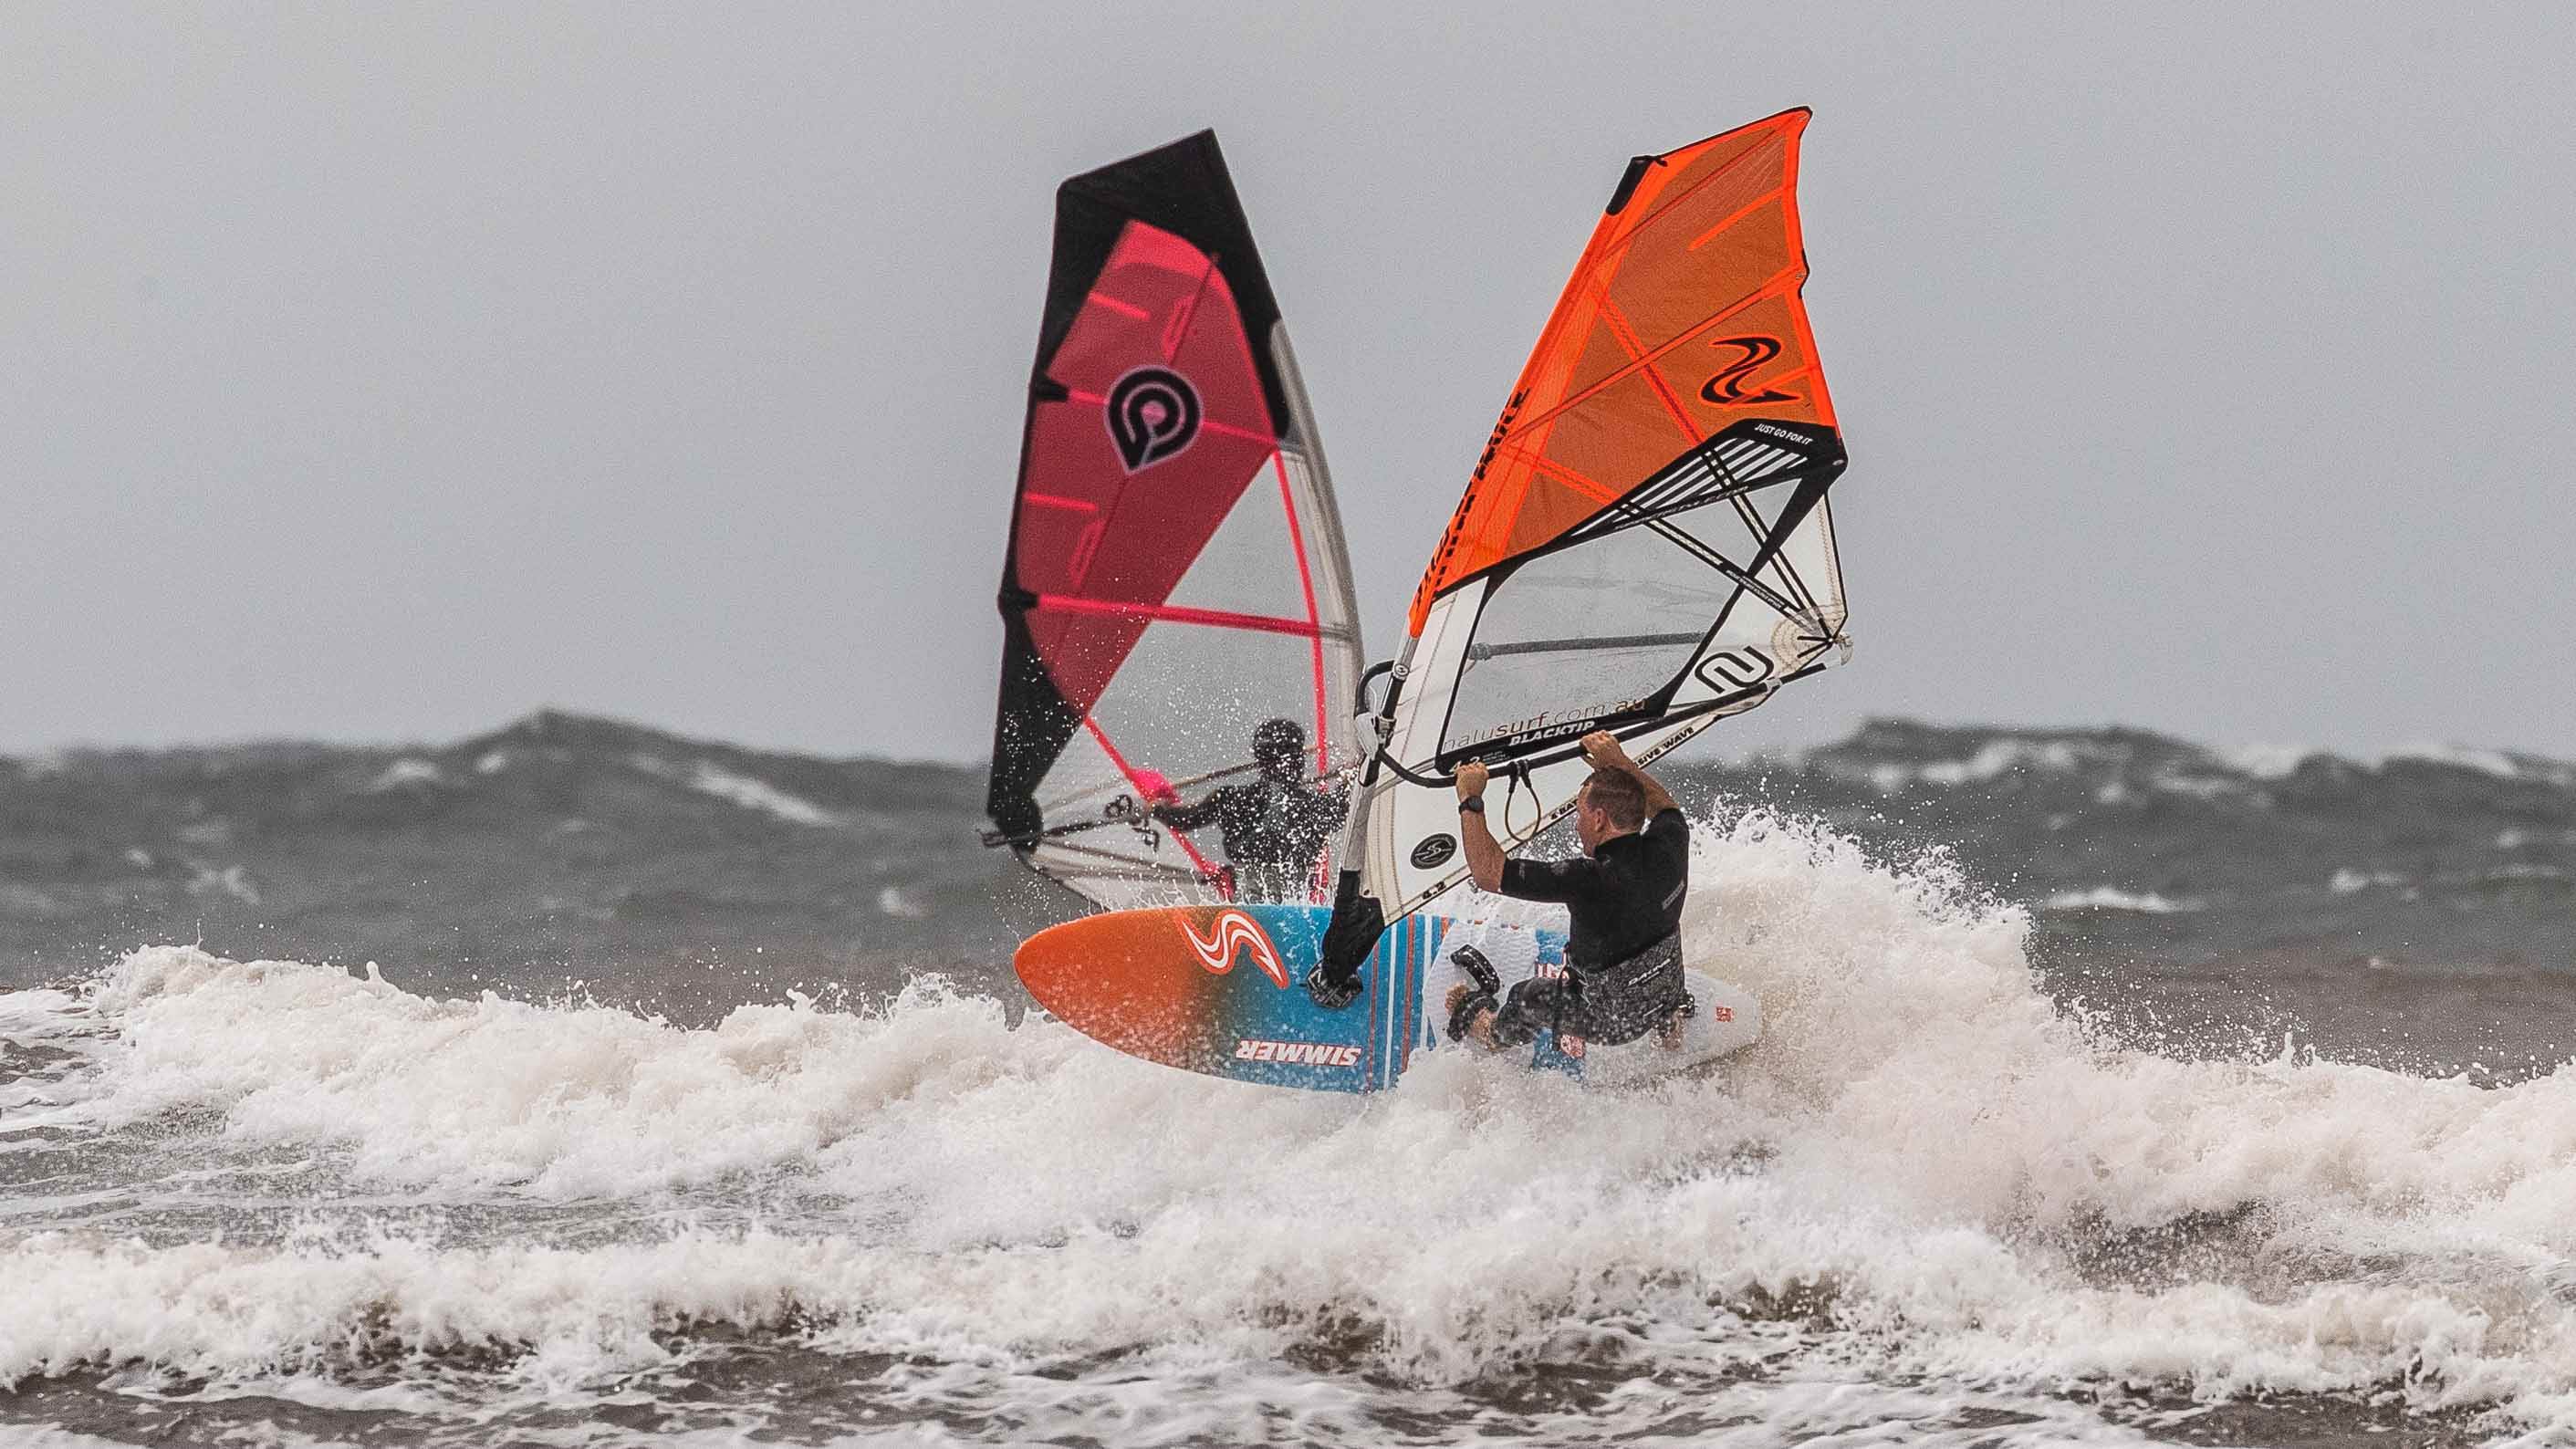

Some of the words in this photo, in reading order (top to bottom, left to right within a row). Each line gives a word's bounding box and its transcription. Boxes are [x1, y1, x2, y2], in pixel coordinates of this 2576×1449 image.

[1755, 423, 1776, 434] JUST
[1773, 428, 1788, 438] GO
[1785, 432, 1804, 443] FOR
[1801, 437, 1814, 445] IT
[1508, 720, 1595, 746] BLACKTIP
[1663, 727, 1695, 749] WAVE
[1235, 1038, 1362, 1067] SIMMER
